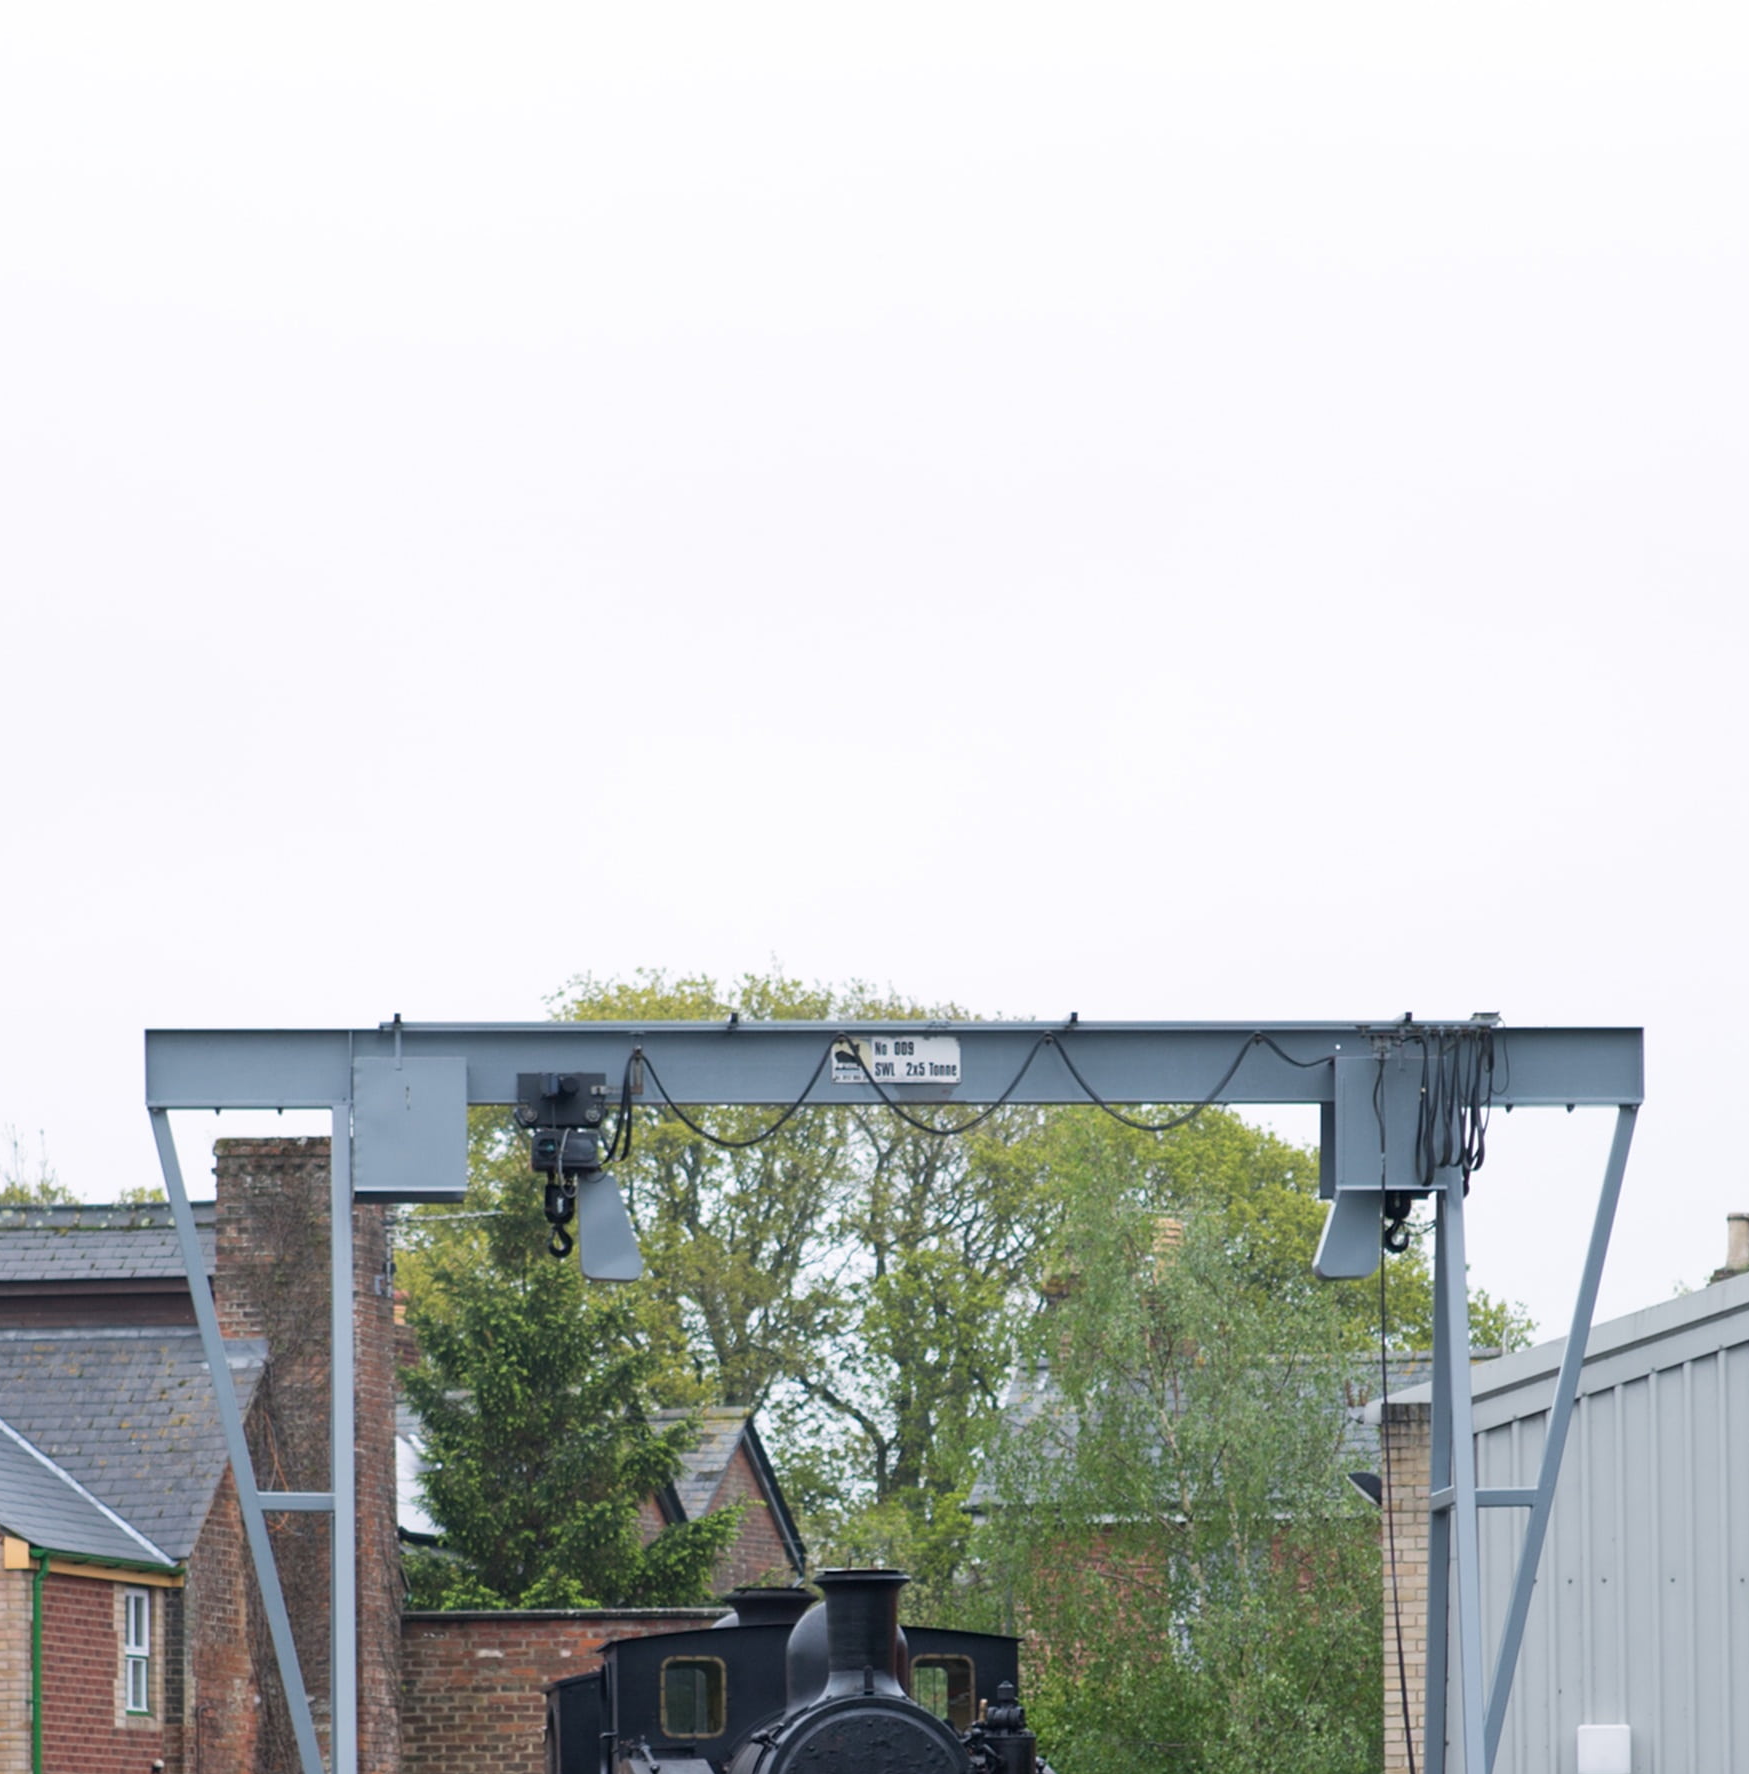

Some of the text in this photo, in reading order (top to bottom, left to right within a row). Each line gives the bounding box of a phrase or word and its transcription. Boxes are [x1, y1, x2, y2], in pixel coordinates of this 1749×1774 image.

[875, 1041, 914, 1056] No 009
[875, 1062, 895, 1077] SWL
[906, 1062, 925, 1077] 2x5
[929, 1062, 957, 1077] Tonne
